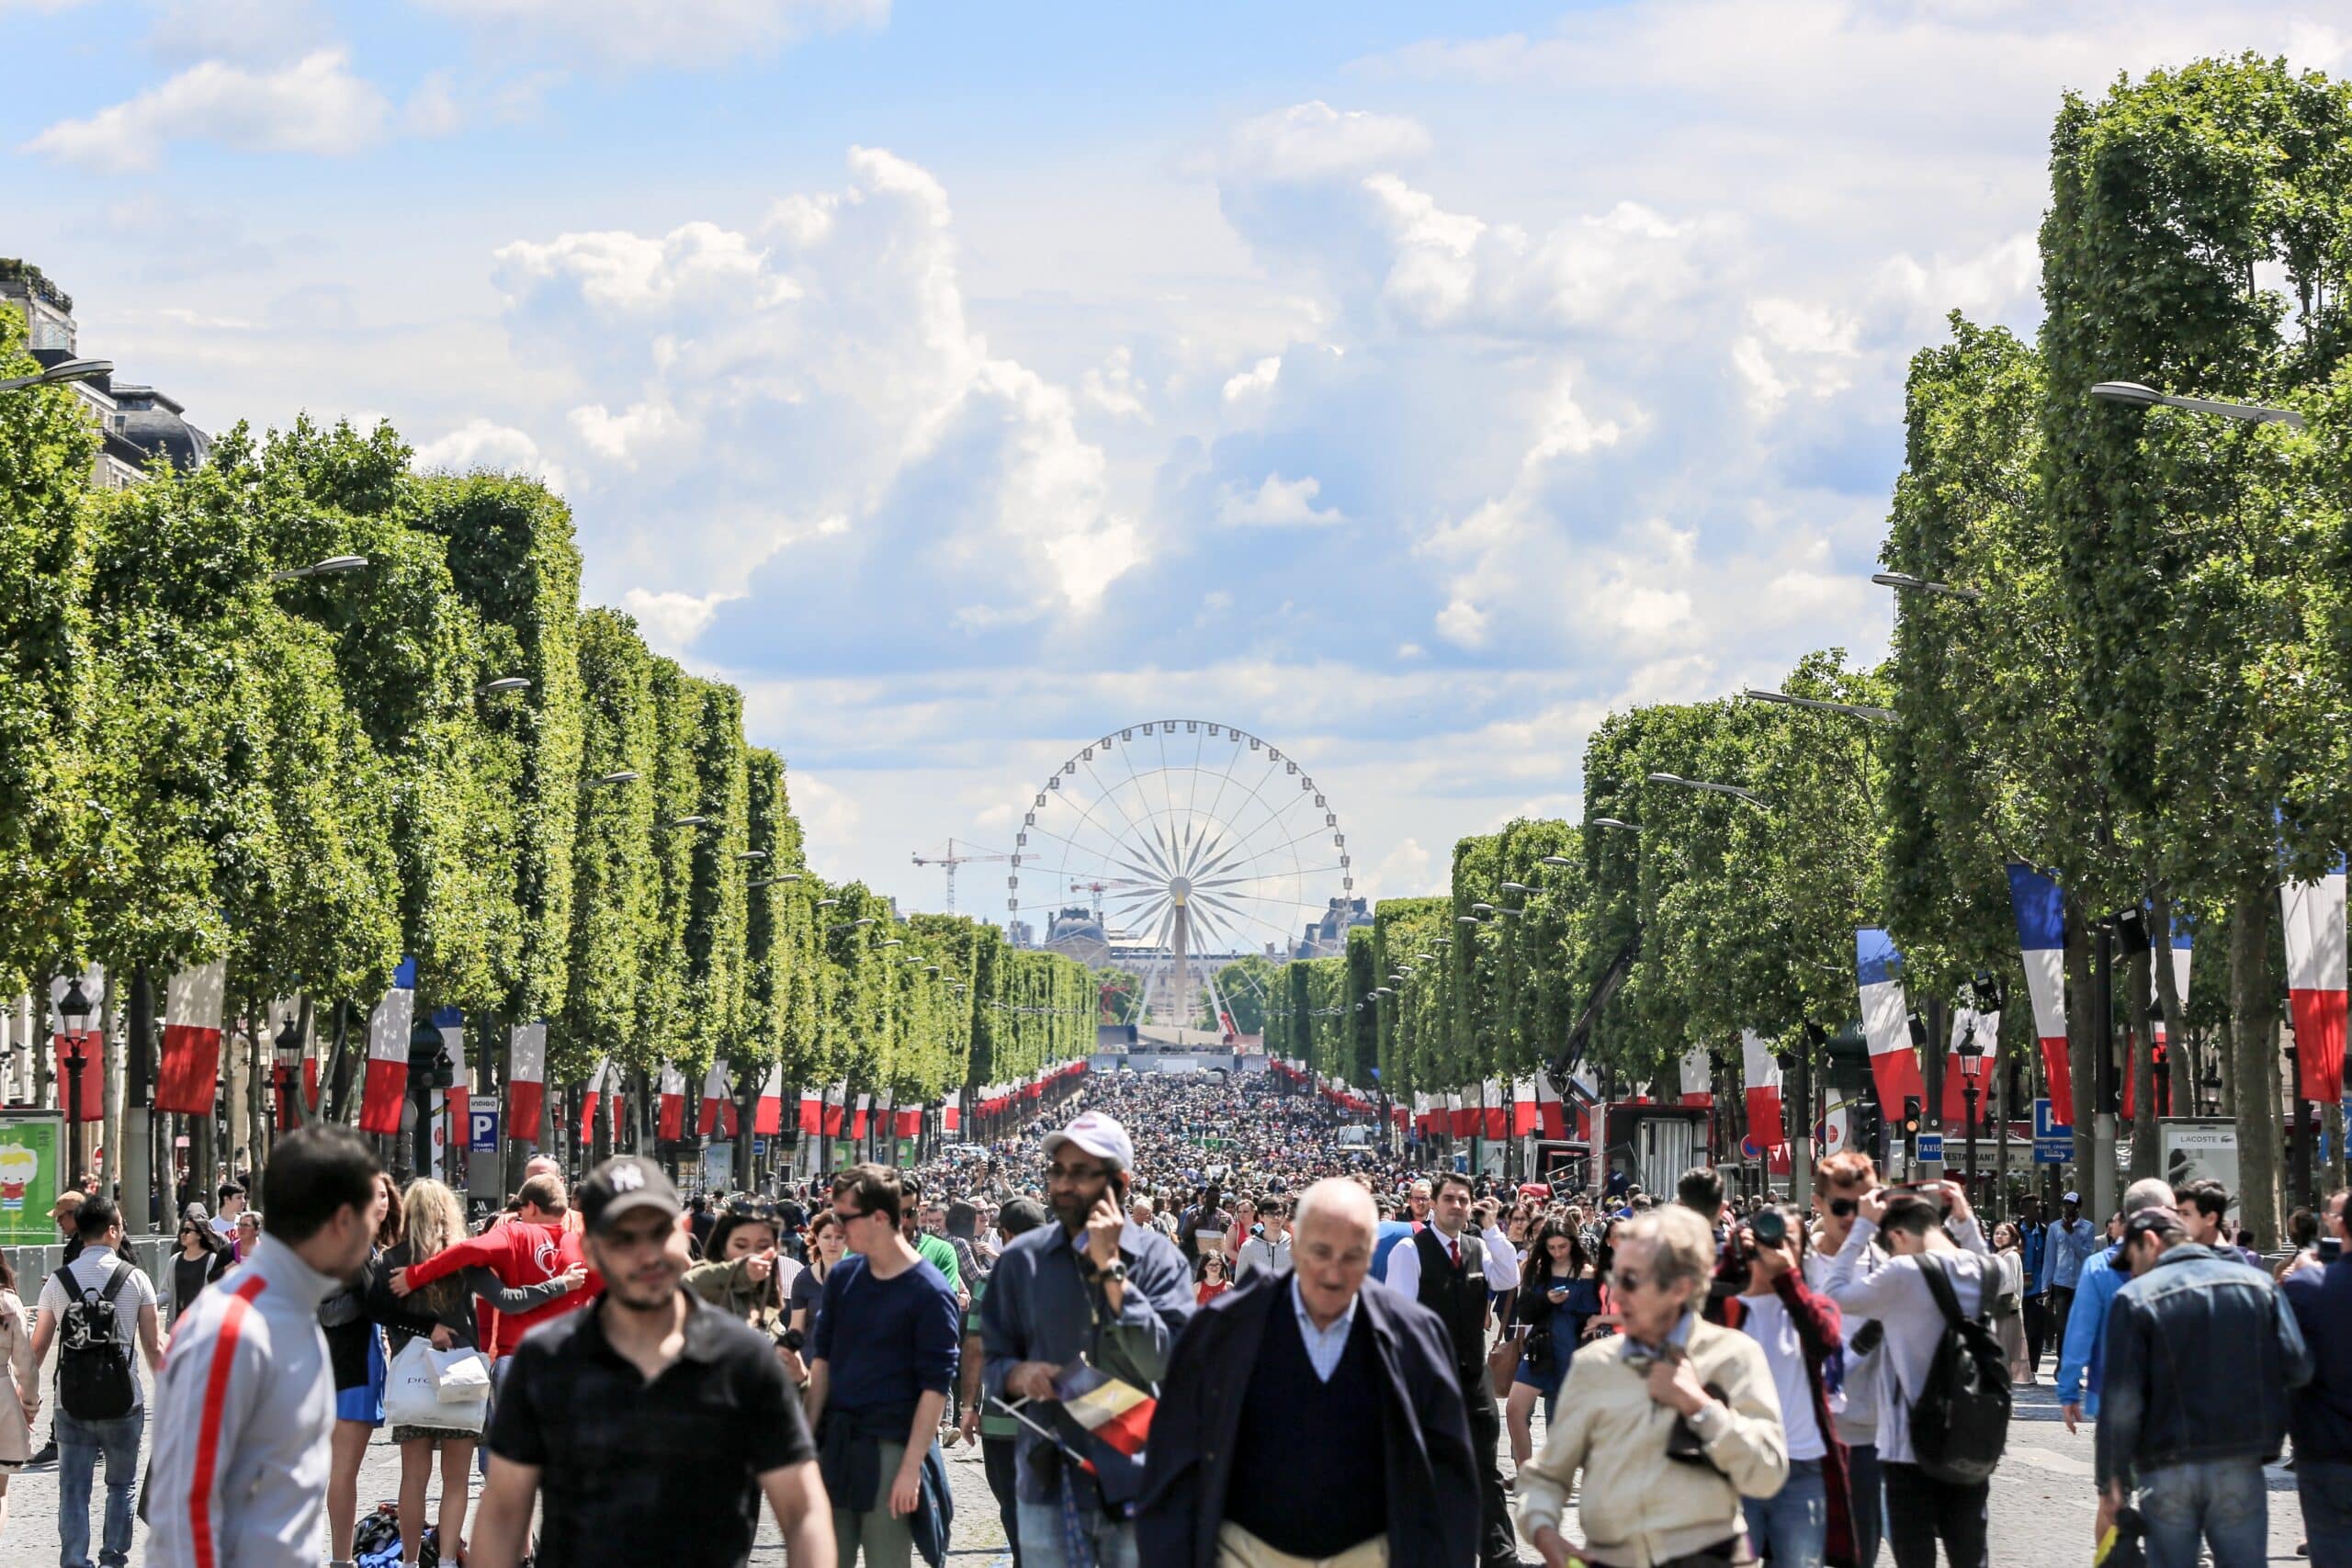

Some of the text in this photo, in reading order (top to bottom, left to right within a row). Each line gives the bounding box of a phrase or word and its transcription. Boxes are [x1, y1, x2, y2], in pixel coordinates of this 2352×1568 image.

[473, 1115, 492, 1140] P
[1918, 1144, 1941, 1153] TAXIS
[1943, 1153, 1996, 1162] RESTARANT
